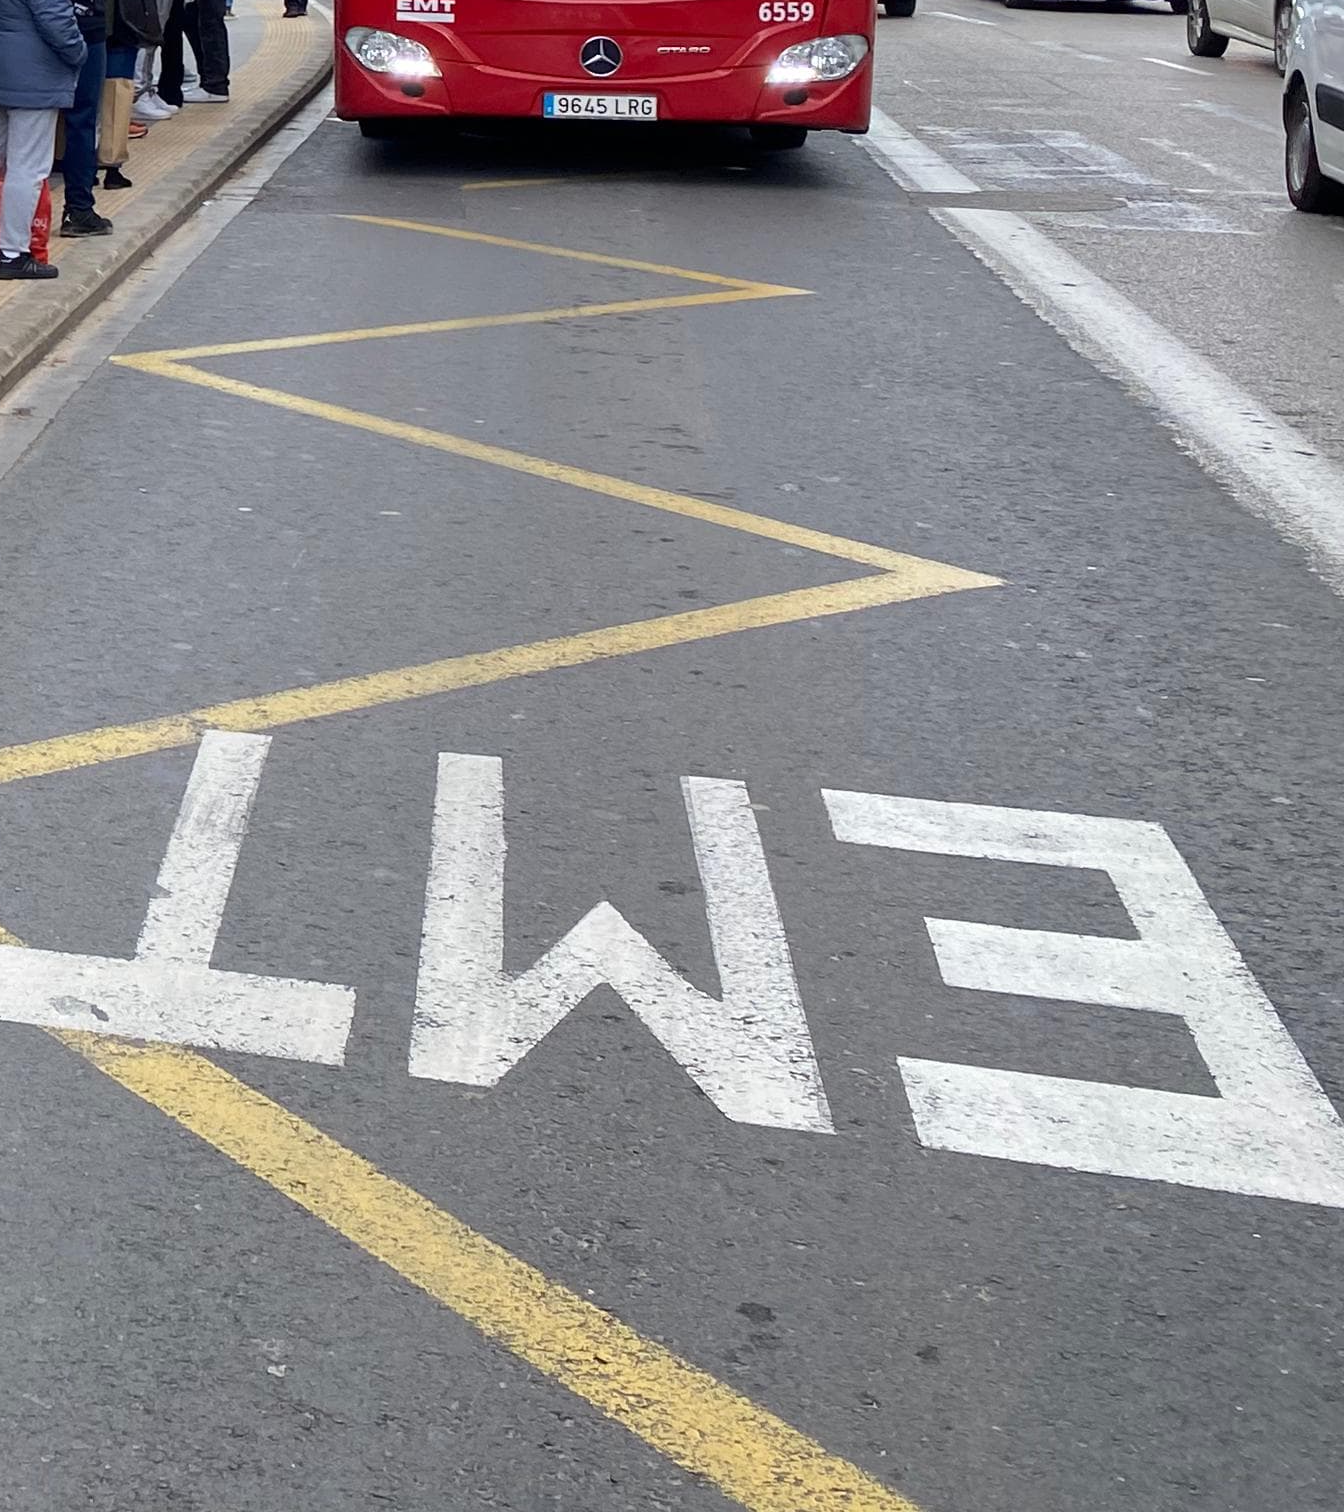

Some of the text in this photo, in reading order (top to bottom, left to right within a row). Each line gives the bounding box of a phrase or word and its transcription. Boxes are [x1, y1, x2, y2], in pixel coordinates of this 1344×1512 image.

[758, 1, 815, 23] 6559
[557, 97, 653, 116] 9645 LRG
